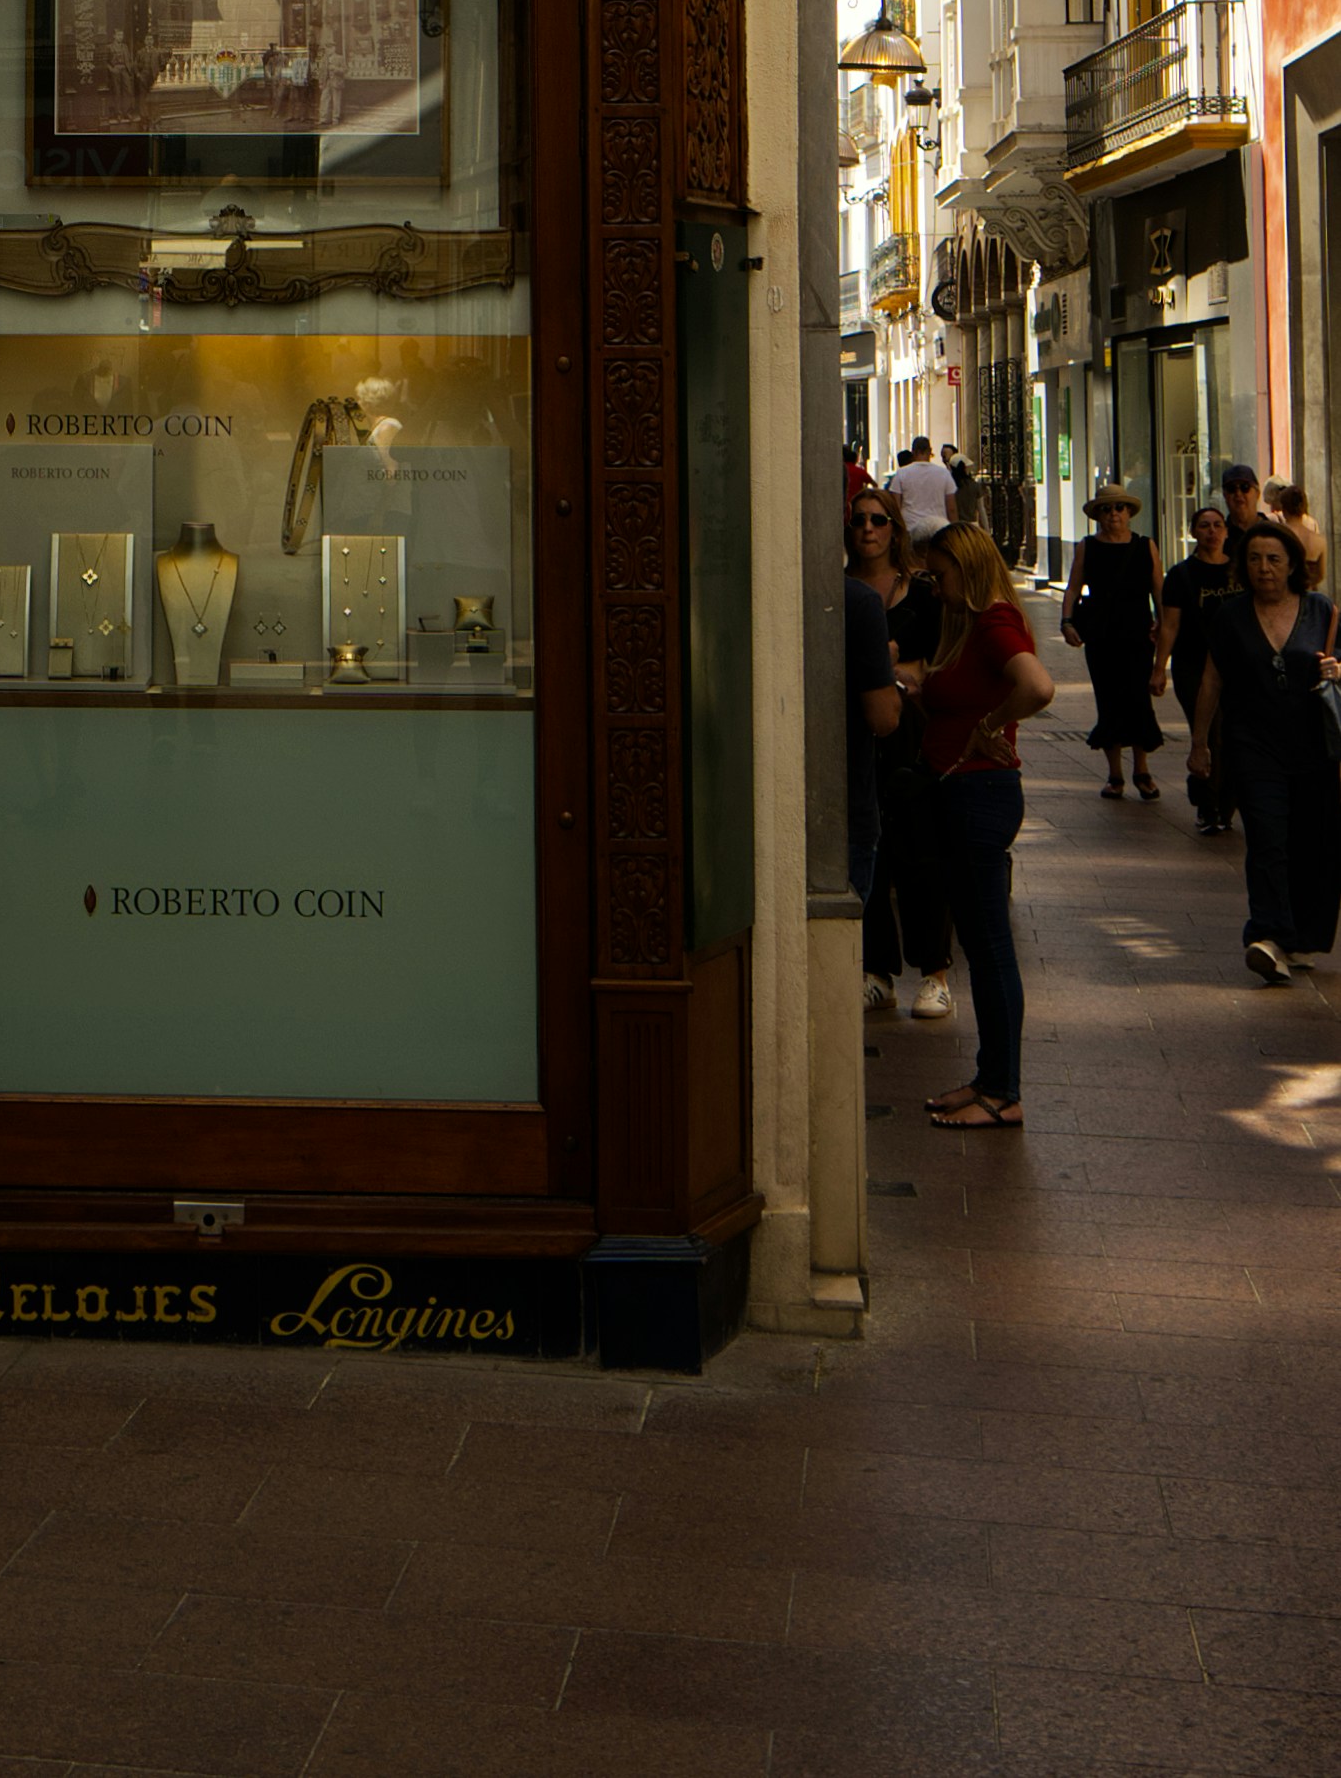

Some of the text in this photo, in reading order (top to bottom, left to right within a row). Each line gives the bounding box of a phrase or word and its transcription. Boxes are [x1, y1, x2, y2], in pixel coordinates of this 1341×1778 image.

[26, 414, 233, 437] ROBERTO COIN
[11, 467, 110, 479] ROBERTO COIN
[367, 469, 467, 481] ROBERTO COIN
[110, 888, 385, 918] ROBERTO COIN
[270, 1263, 516, 1352] Longines
